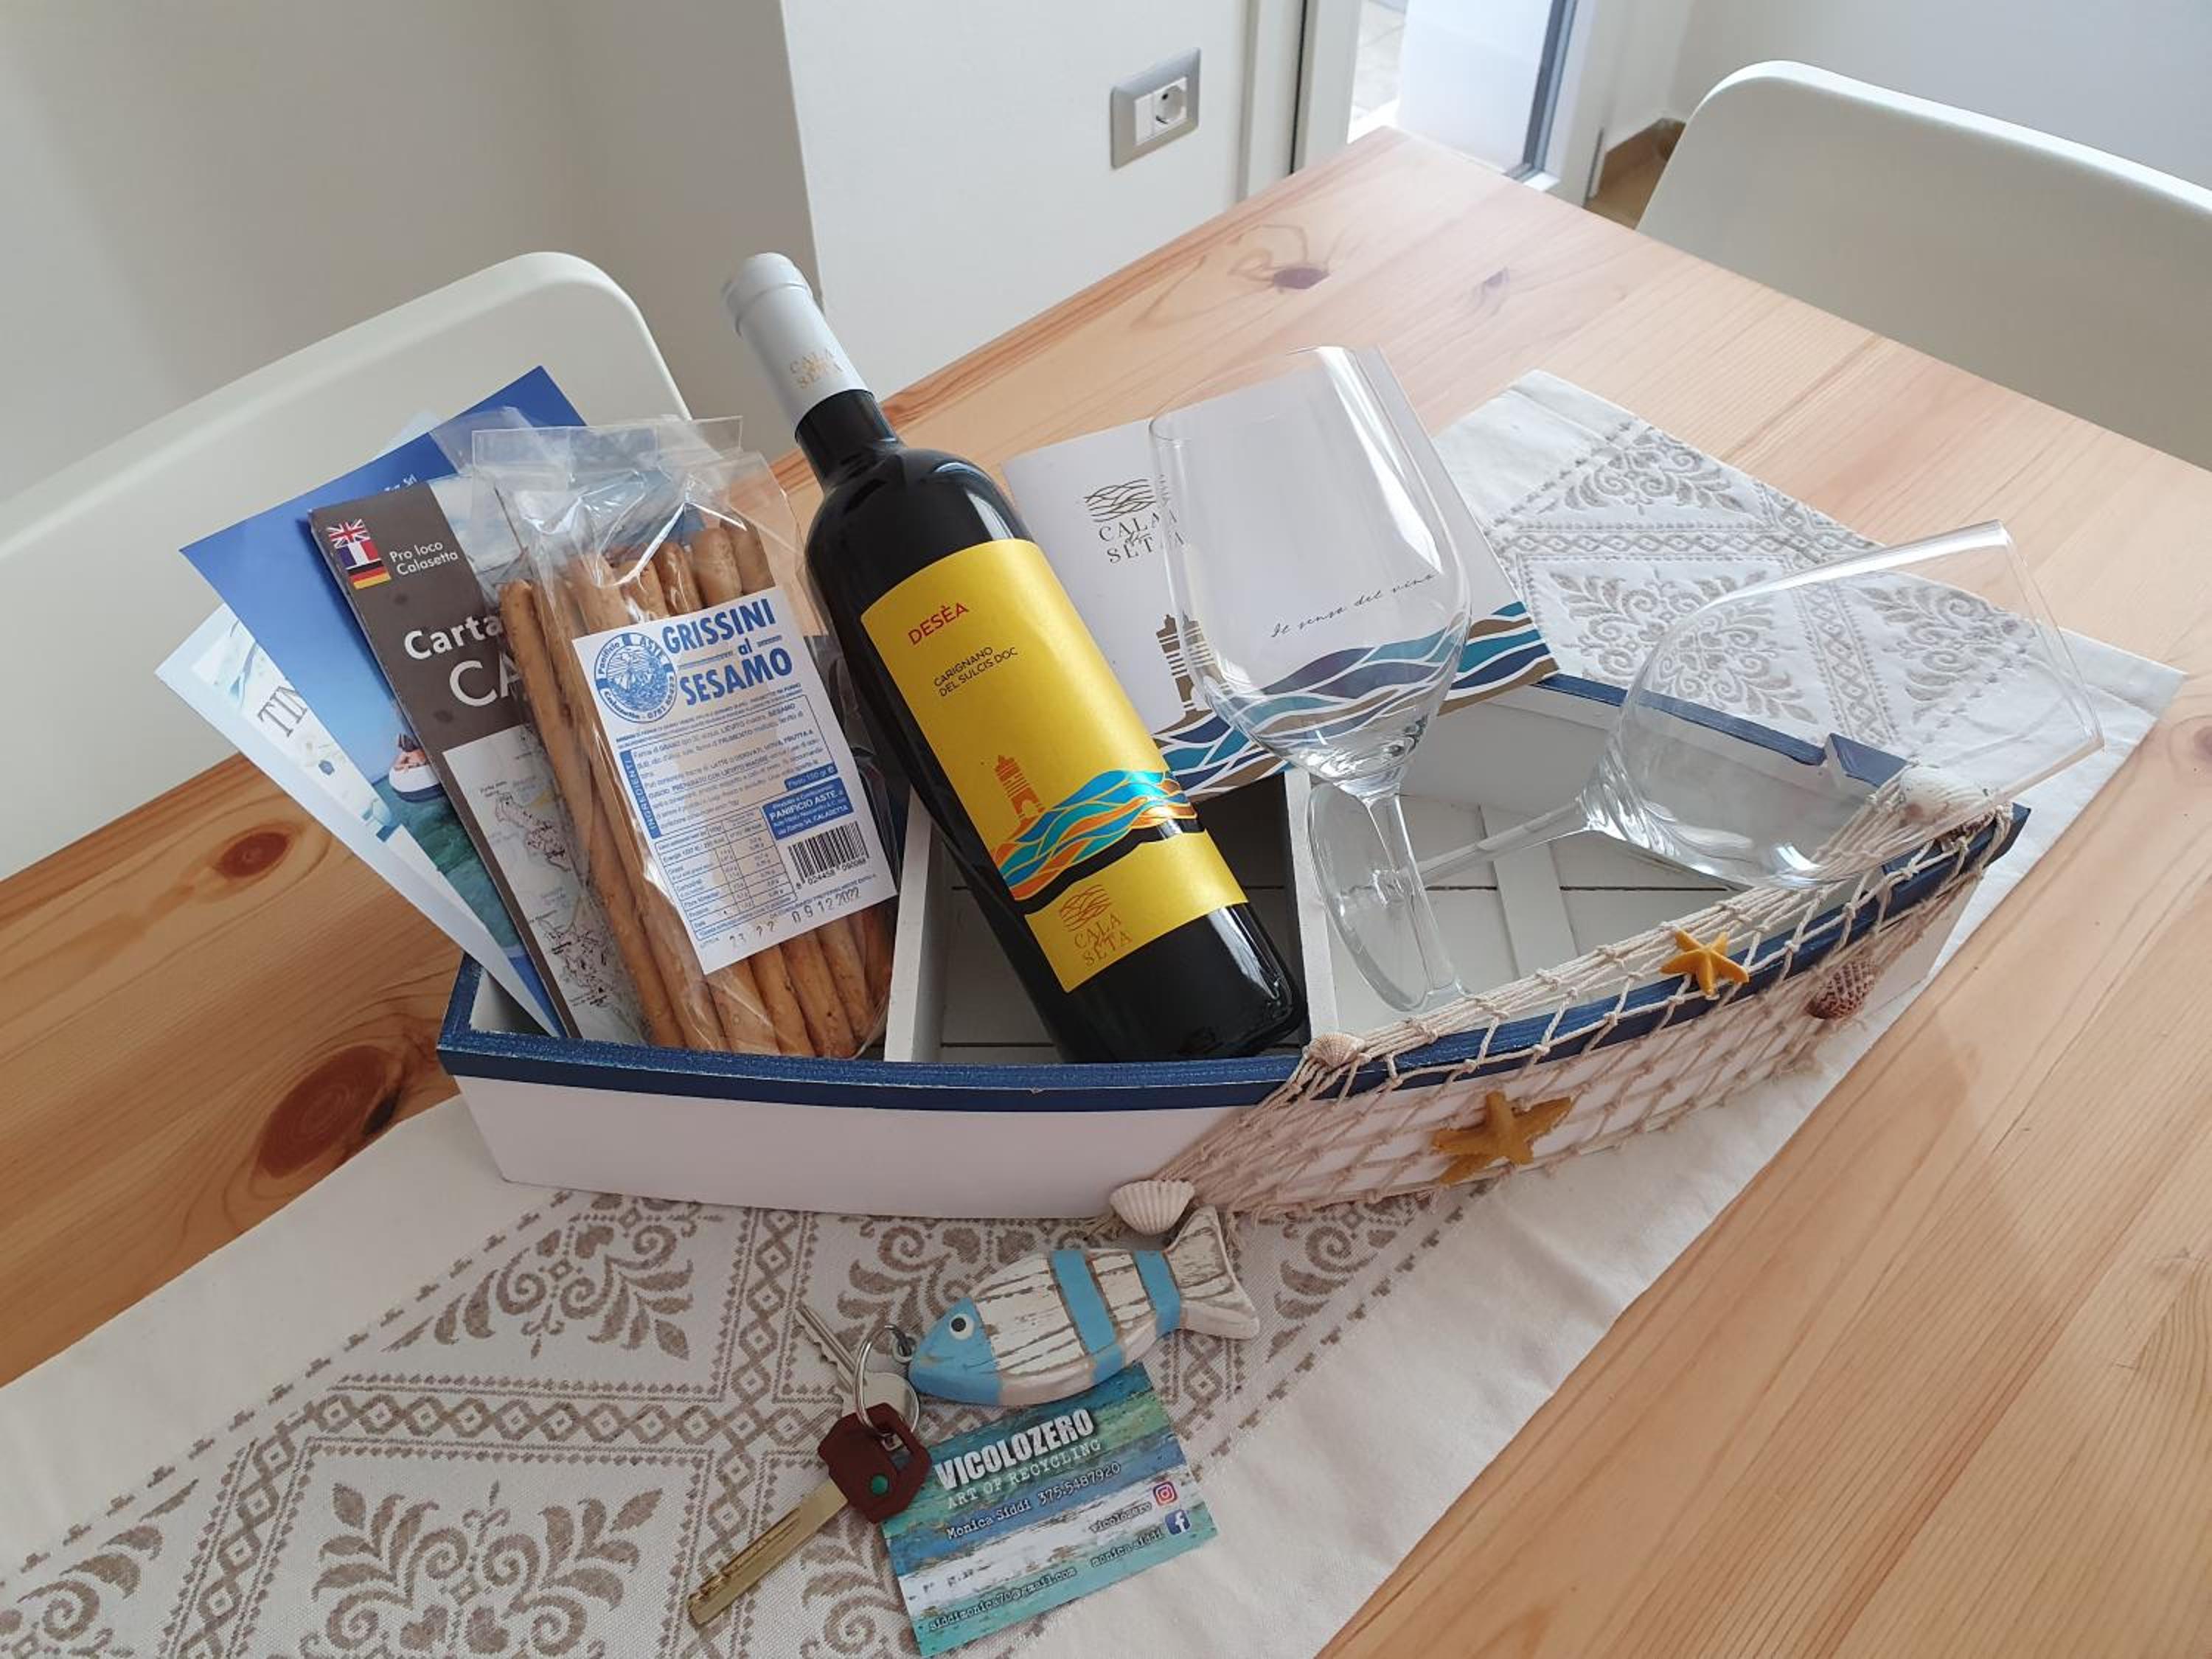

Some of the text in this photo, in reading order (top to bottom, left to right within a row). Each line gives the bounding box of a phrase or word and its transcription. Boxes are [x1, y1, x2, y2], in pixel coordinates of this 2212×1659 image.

[389, 542, 443, 563] Pro loco
[397, 552, 458, 574] Calasetta
[1354, 590, 1382, 607] del
[1391, 574, 1435, 594] vino
[404, 616, 503, 660] Carta
[661, 599, 776, 654] GRISSINI
[908, 602, 970, 645] DESÈA
[598, 641, 620, 674] Panificio
[738, 638, 753, 655] al
[933, 646, 994, 686] CARIGNANO
[679, 647, 793, 706] SESAMO
[939, 647, 1019, 698] DEL SULCIS DOC
[769, 799, 813, 821] PANIFICIO
[1074, 914, 1121, 949] CALA
[933, 1409, 1096, 1491] VICOLOZERO
[947, 1439, 1102, 1509] ART OF RECYCLING
[947, 1515, 993, 1540] Monica
[997, 1498, 1032, 1522] Siddi
